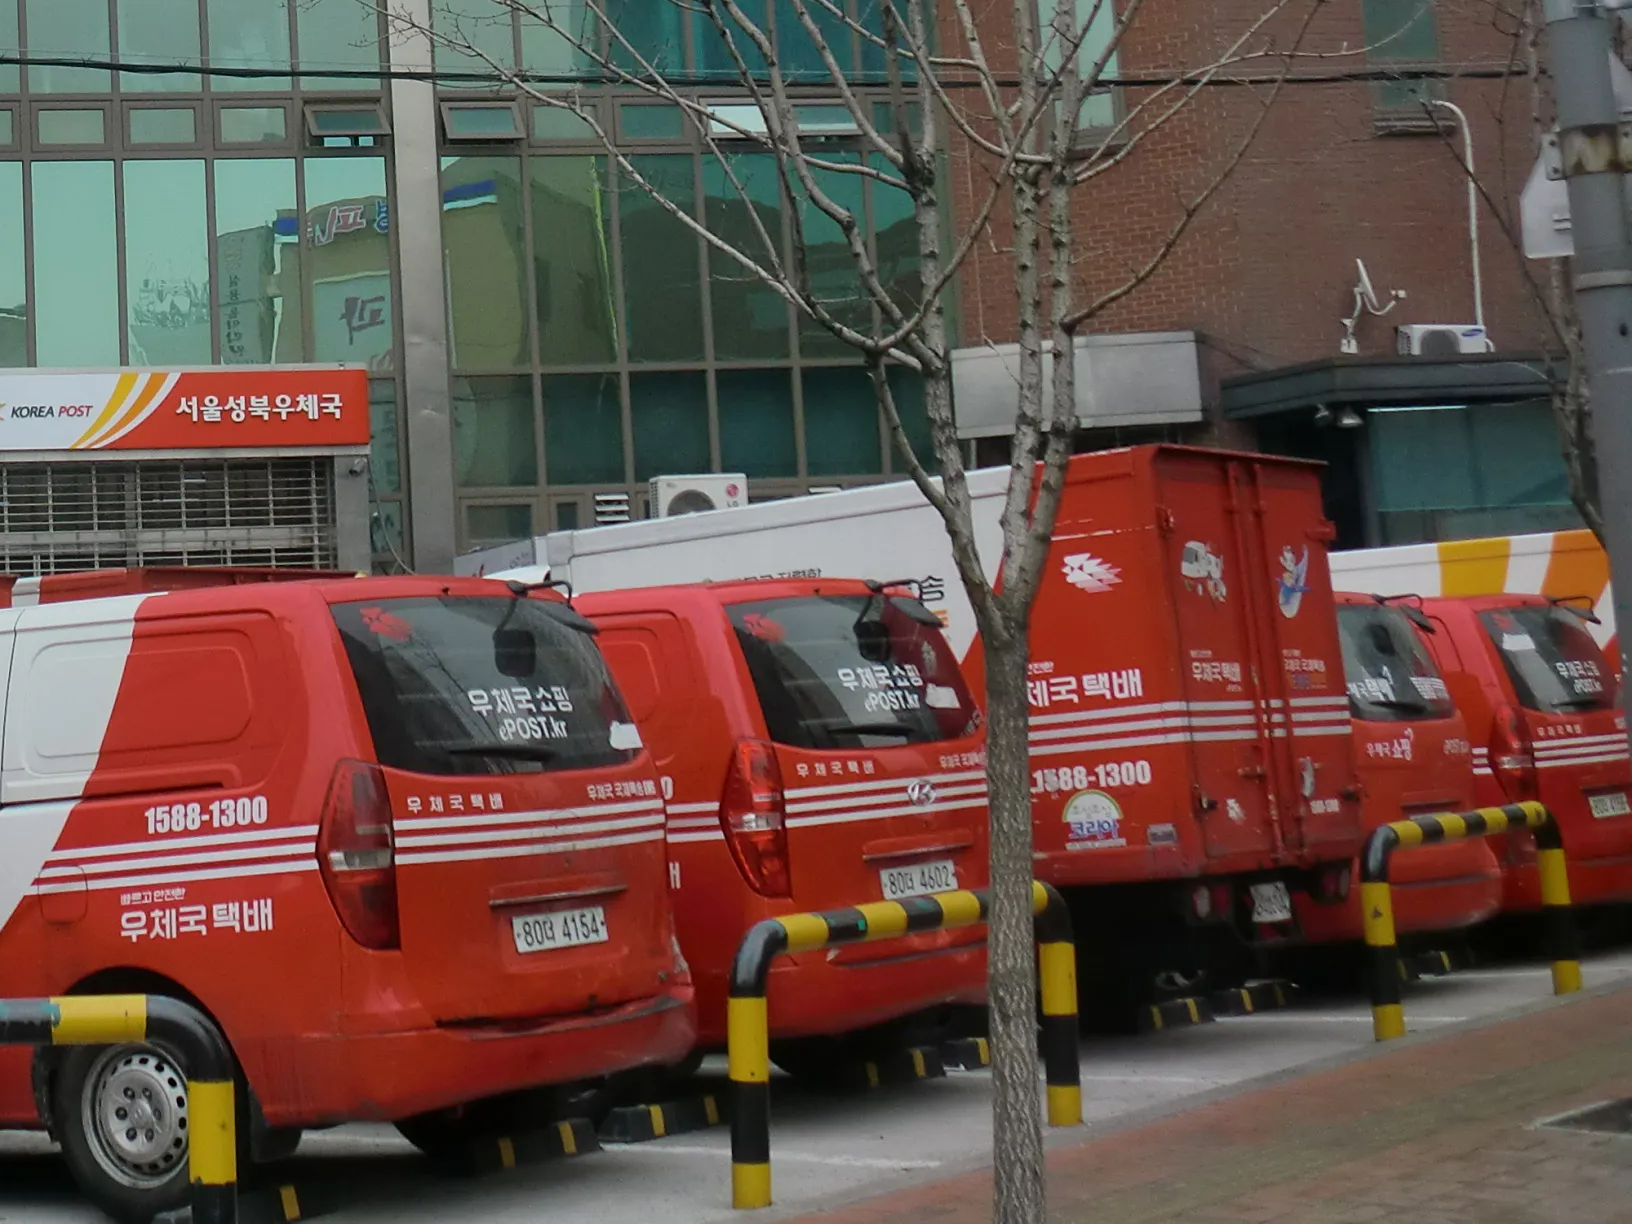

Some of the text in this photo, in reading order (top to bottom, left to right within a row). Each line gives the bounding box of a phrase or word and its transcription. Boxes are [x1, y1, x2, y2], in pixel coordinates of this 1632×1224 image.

[10, 403, 94, 420] KOREA POST
[175, 393, 344, 423] 서울성북우체국
[498, 719, 568, 743] ePOST.kr
[144, 795, 269, 835] 1588-1300
[920, 864, 951, 890] 4602
[120, 890, 152, 906] 빠르고
[522, 912, 600, 947] 80더 4154
